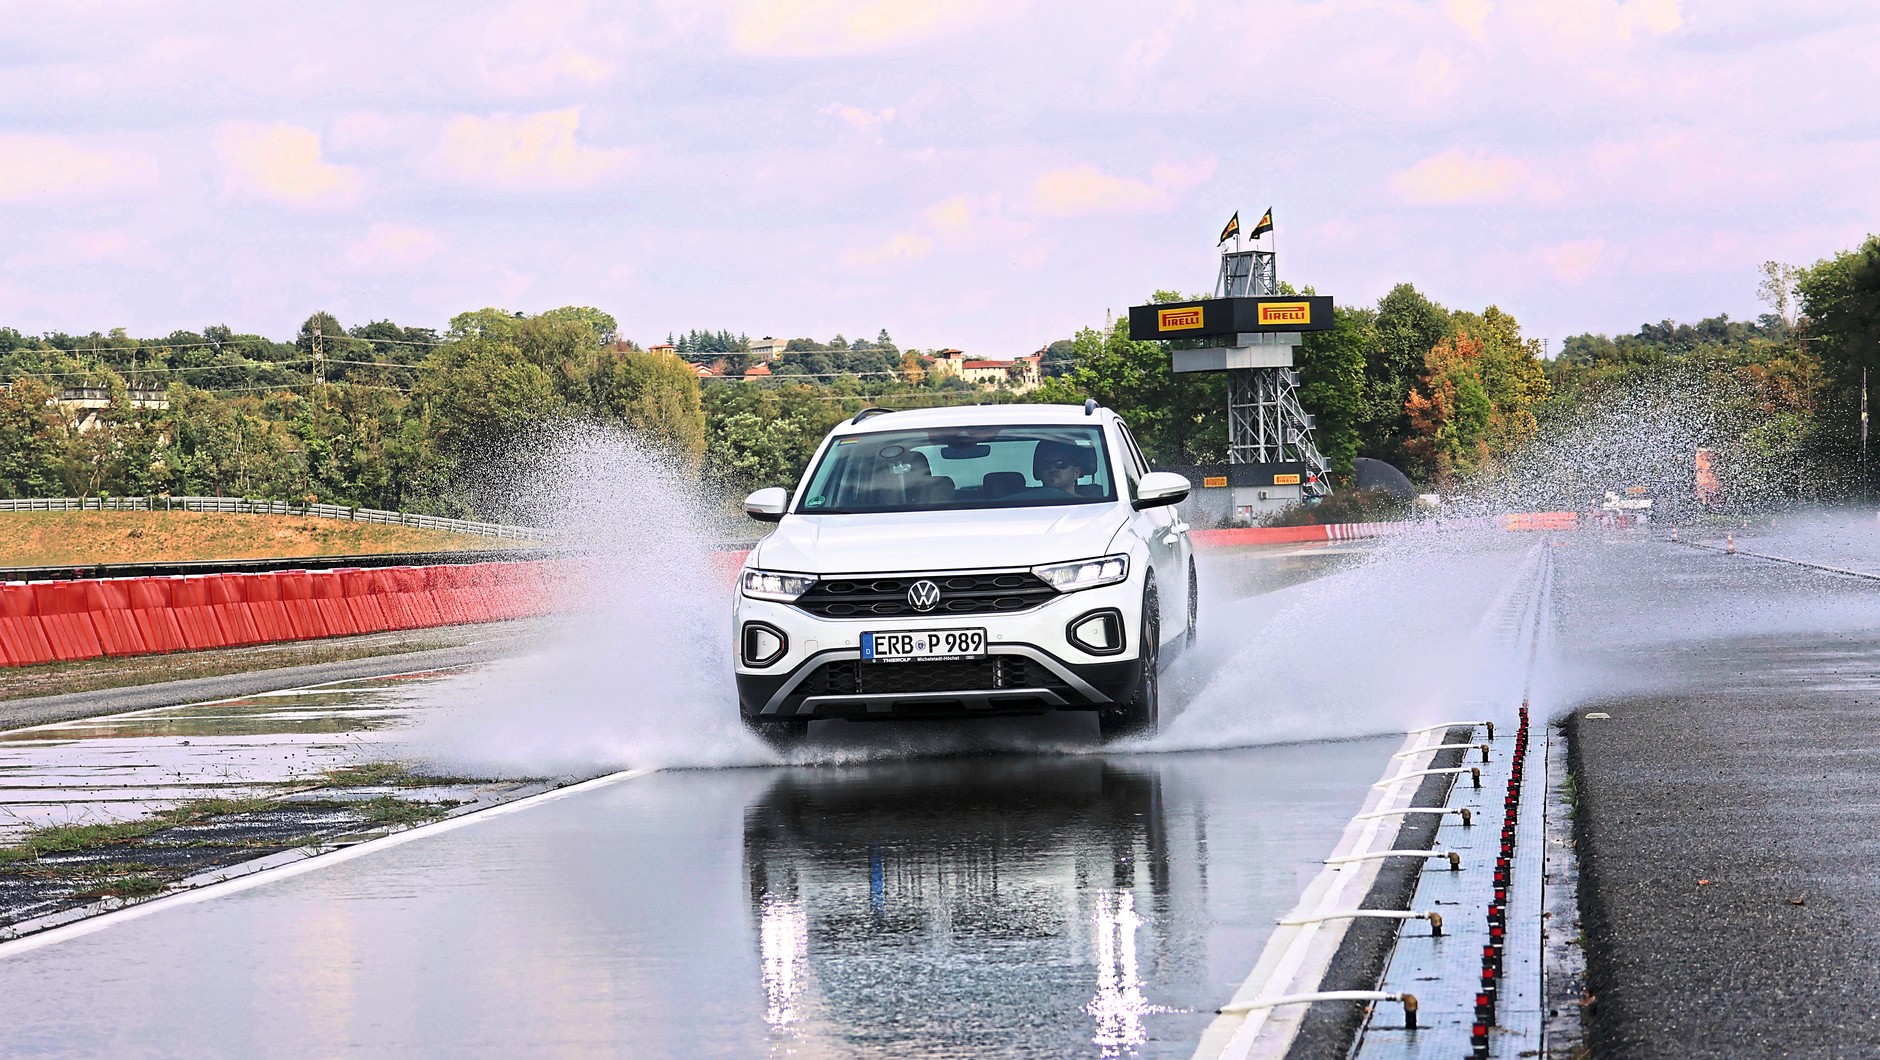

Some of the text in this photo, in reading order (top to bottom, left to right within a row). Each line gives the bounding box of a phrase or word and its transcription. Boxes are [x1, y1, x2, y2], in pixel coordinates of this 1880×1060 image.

[1162, 311, 1199, 327] PIRELLI
[1262, 306, 1305, 320] PIRELLI
[1276, 475, 1298, 483] PIRELLI
[874, 632, 982, 655] ERB P 989
